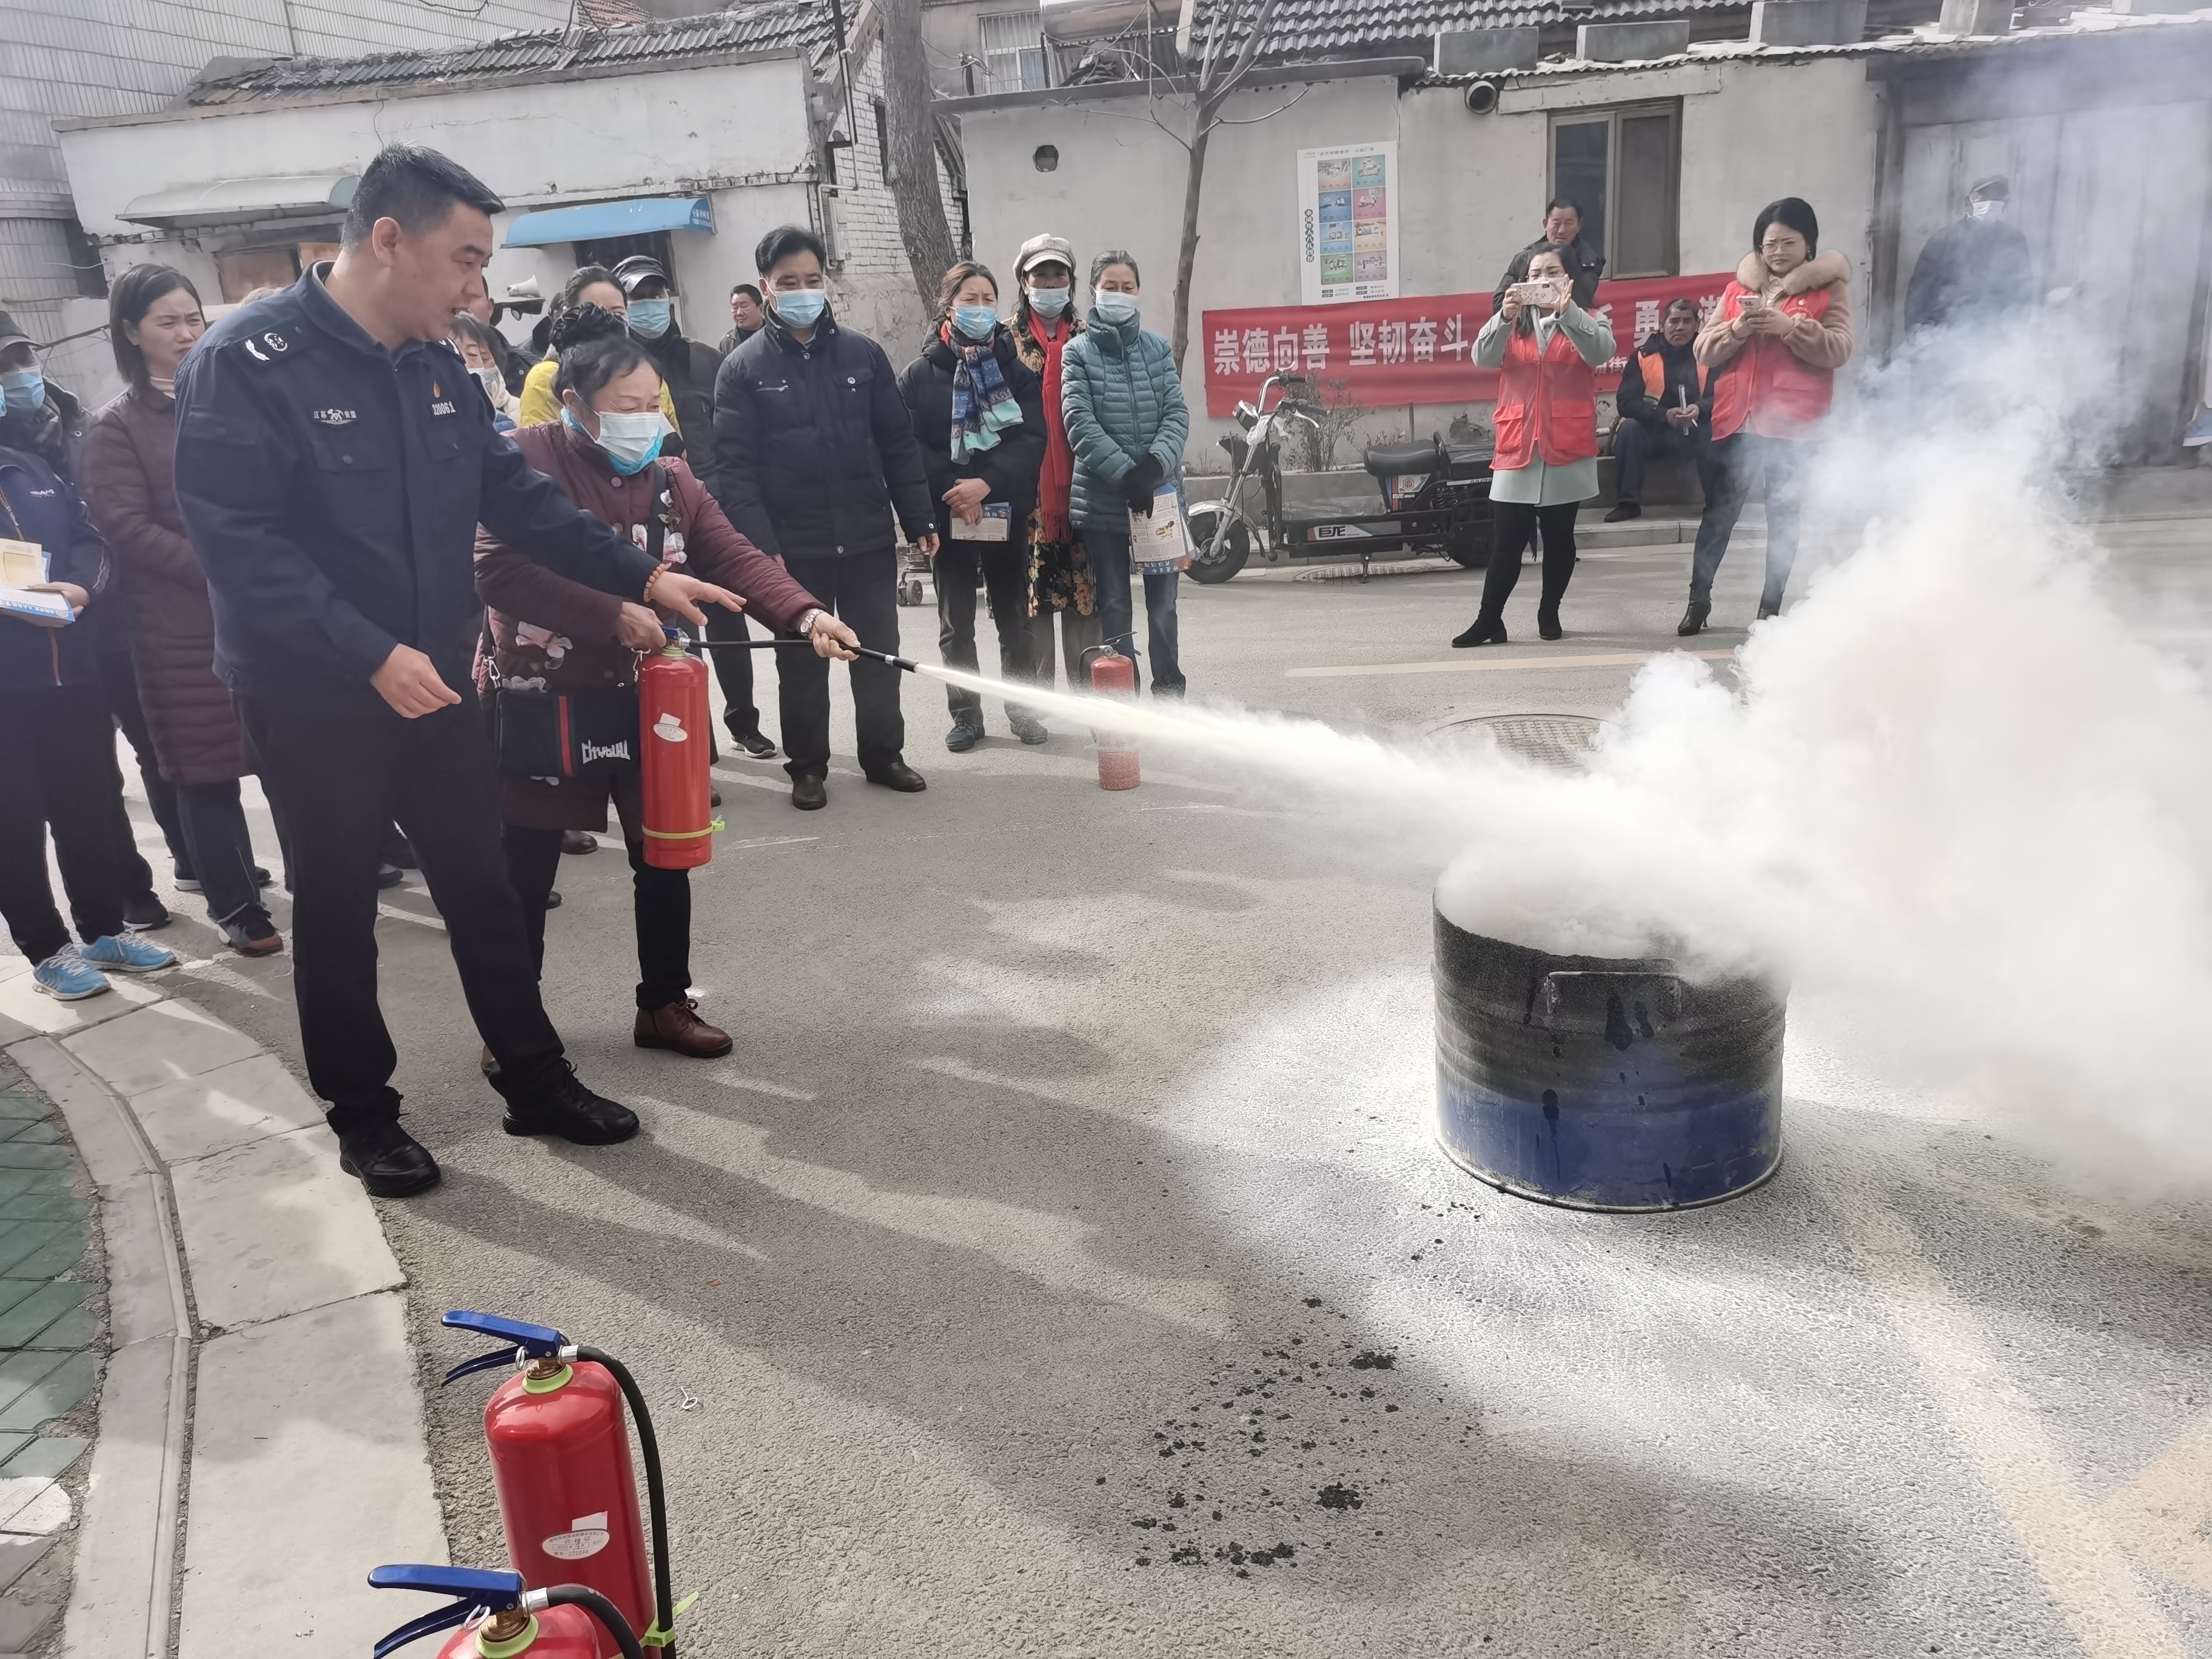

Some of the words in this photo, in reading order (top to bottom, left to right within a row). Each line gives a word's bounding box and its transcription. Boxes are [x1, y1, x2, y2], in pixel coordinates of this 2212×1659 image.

[1214, 323, 1330, 375] 崇德向善
[1349, 313, 1469, 366] 坚韧奋斗
[432, 401, 456, 416] 320061
[565, 1536, 591, 1544] 合格证
